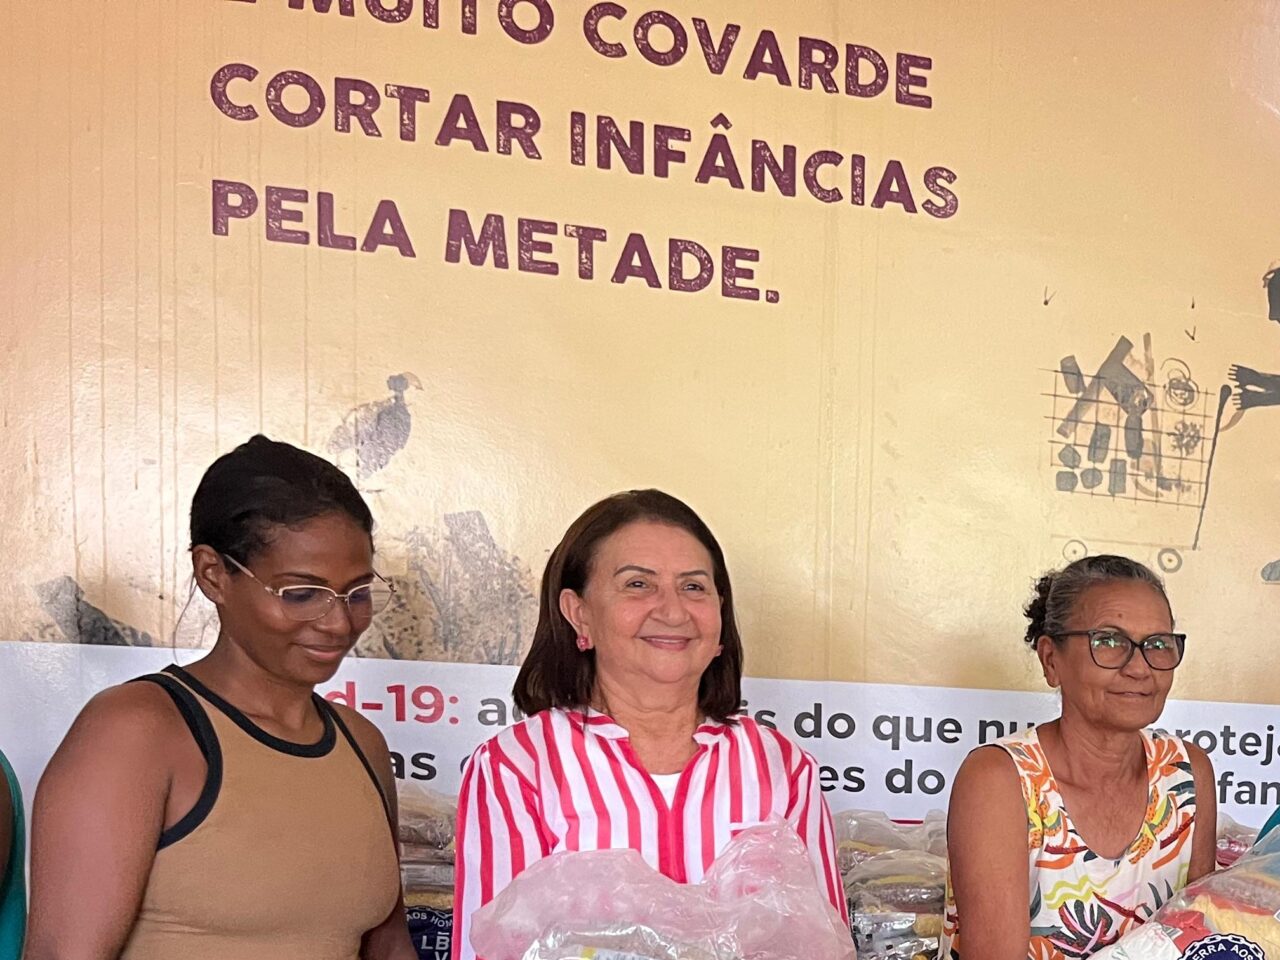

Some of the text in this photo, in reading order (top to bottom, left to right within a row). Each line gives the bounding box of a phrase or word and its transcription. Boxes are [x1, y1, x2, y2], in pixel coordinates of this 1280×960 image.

[584, 3, 934, 110] COVARDE
[210, 62, 959, 219] CORTAR INFÂNCIAS
[211, 179, 780, 304] PELA METADE.
[793, 702, 857, 739] do
[871, 714, 964, 751] que
[884, 759, 946, 795] do
